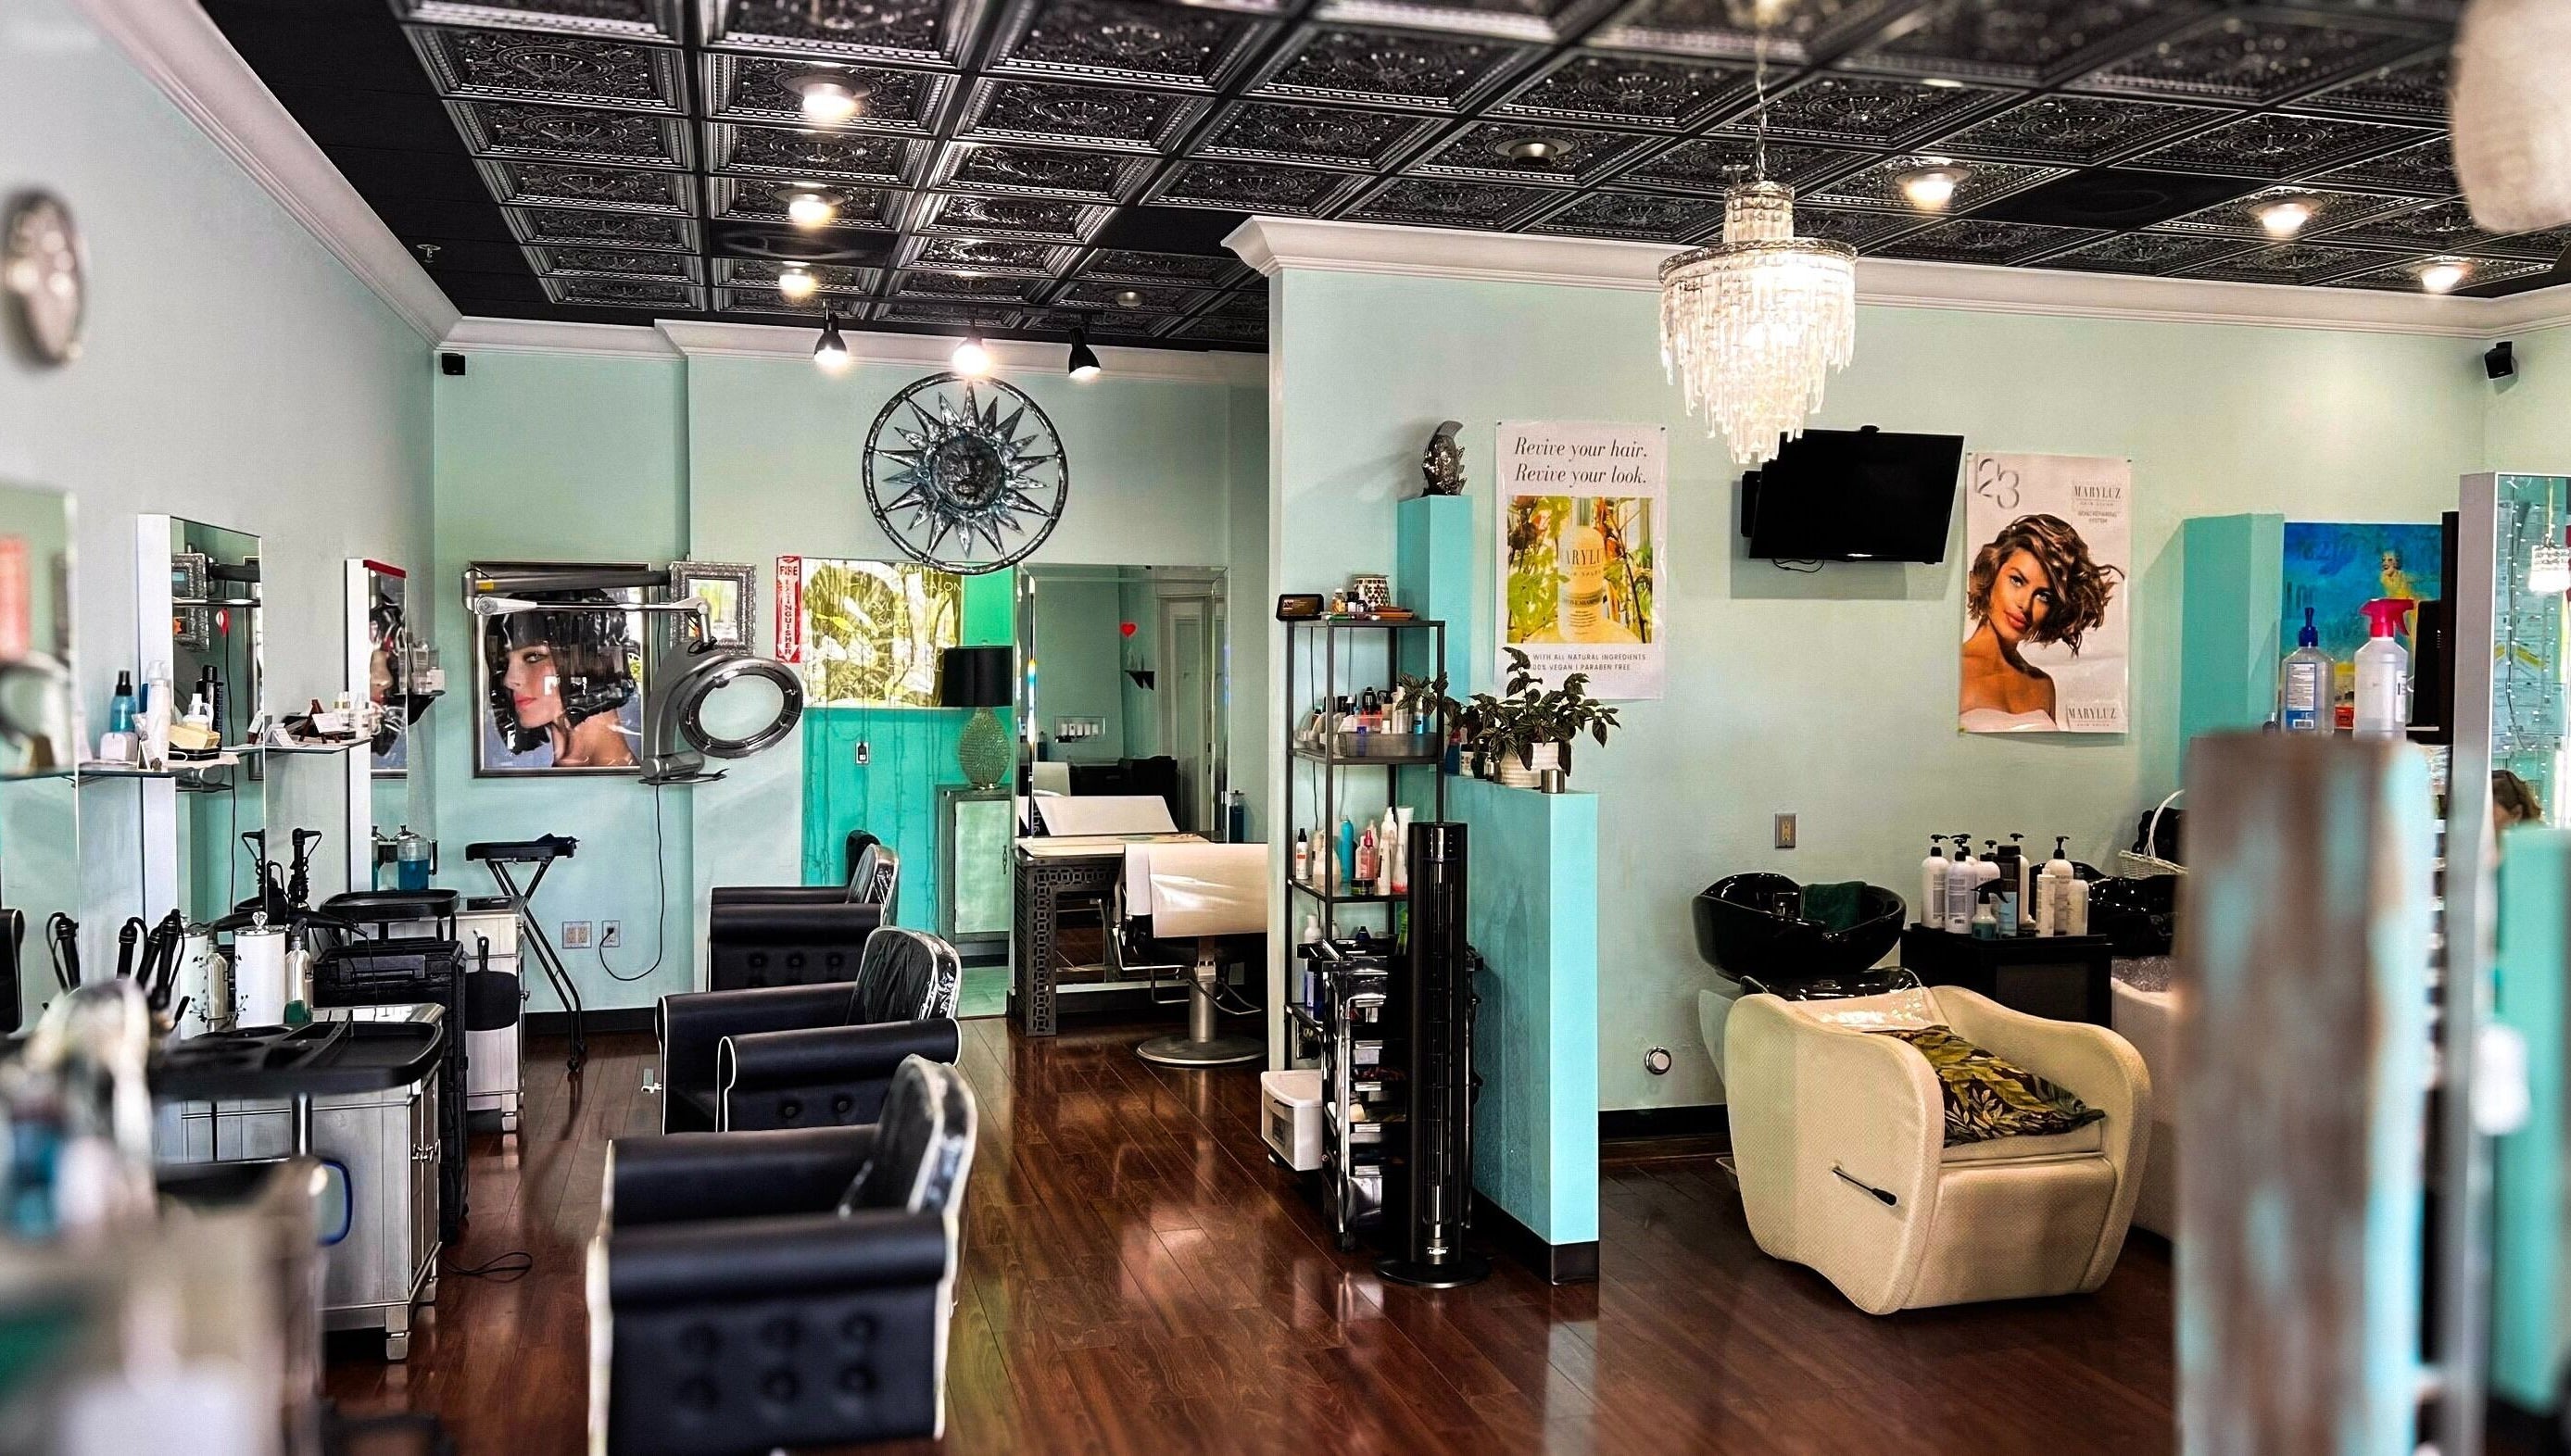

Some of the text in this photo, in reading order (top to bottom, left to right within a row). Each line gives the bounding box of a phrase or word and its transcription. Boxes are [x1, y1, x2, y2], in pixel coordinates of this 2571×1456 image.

[1515, 436, 1647, 462] Revive your hair.
[1516, 463, 1646, 488] Revive your look.
[2074, 485, 2121, 499] MARYLUZ
[779, 565, 798, 576] FIRE
[2069, 708, 2116, 720] MARYLUZ
